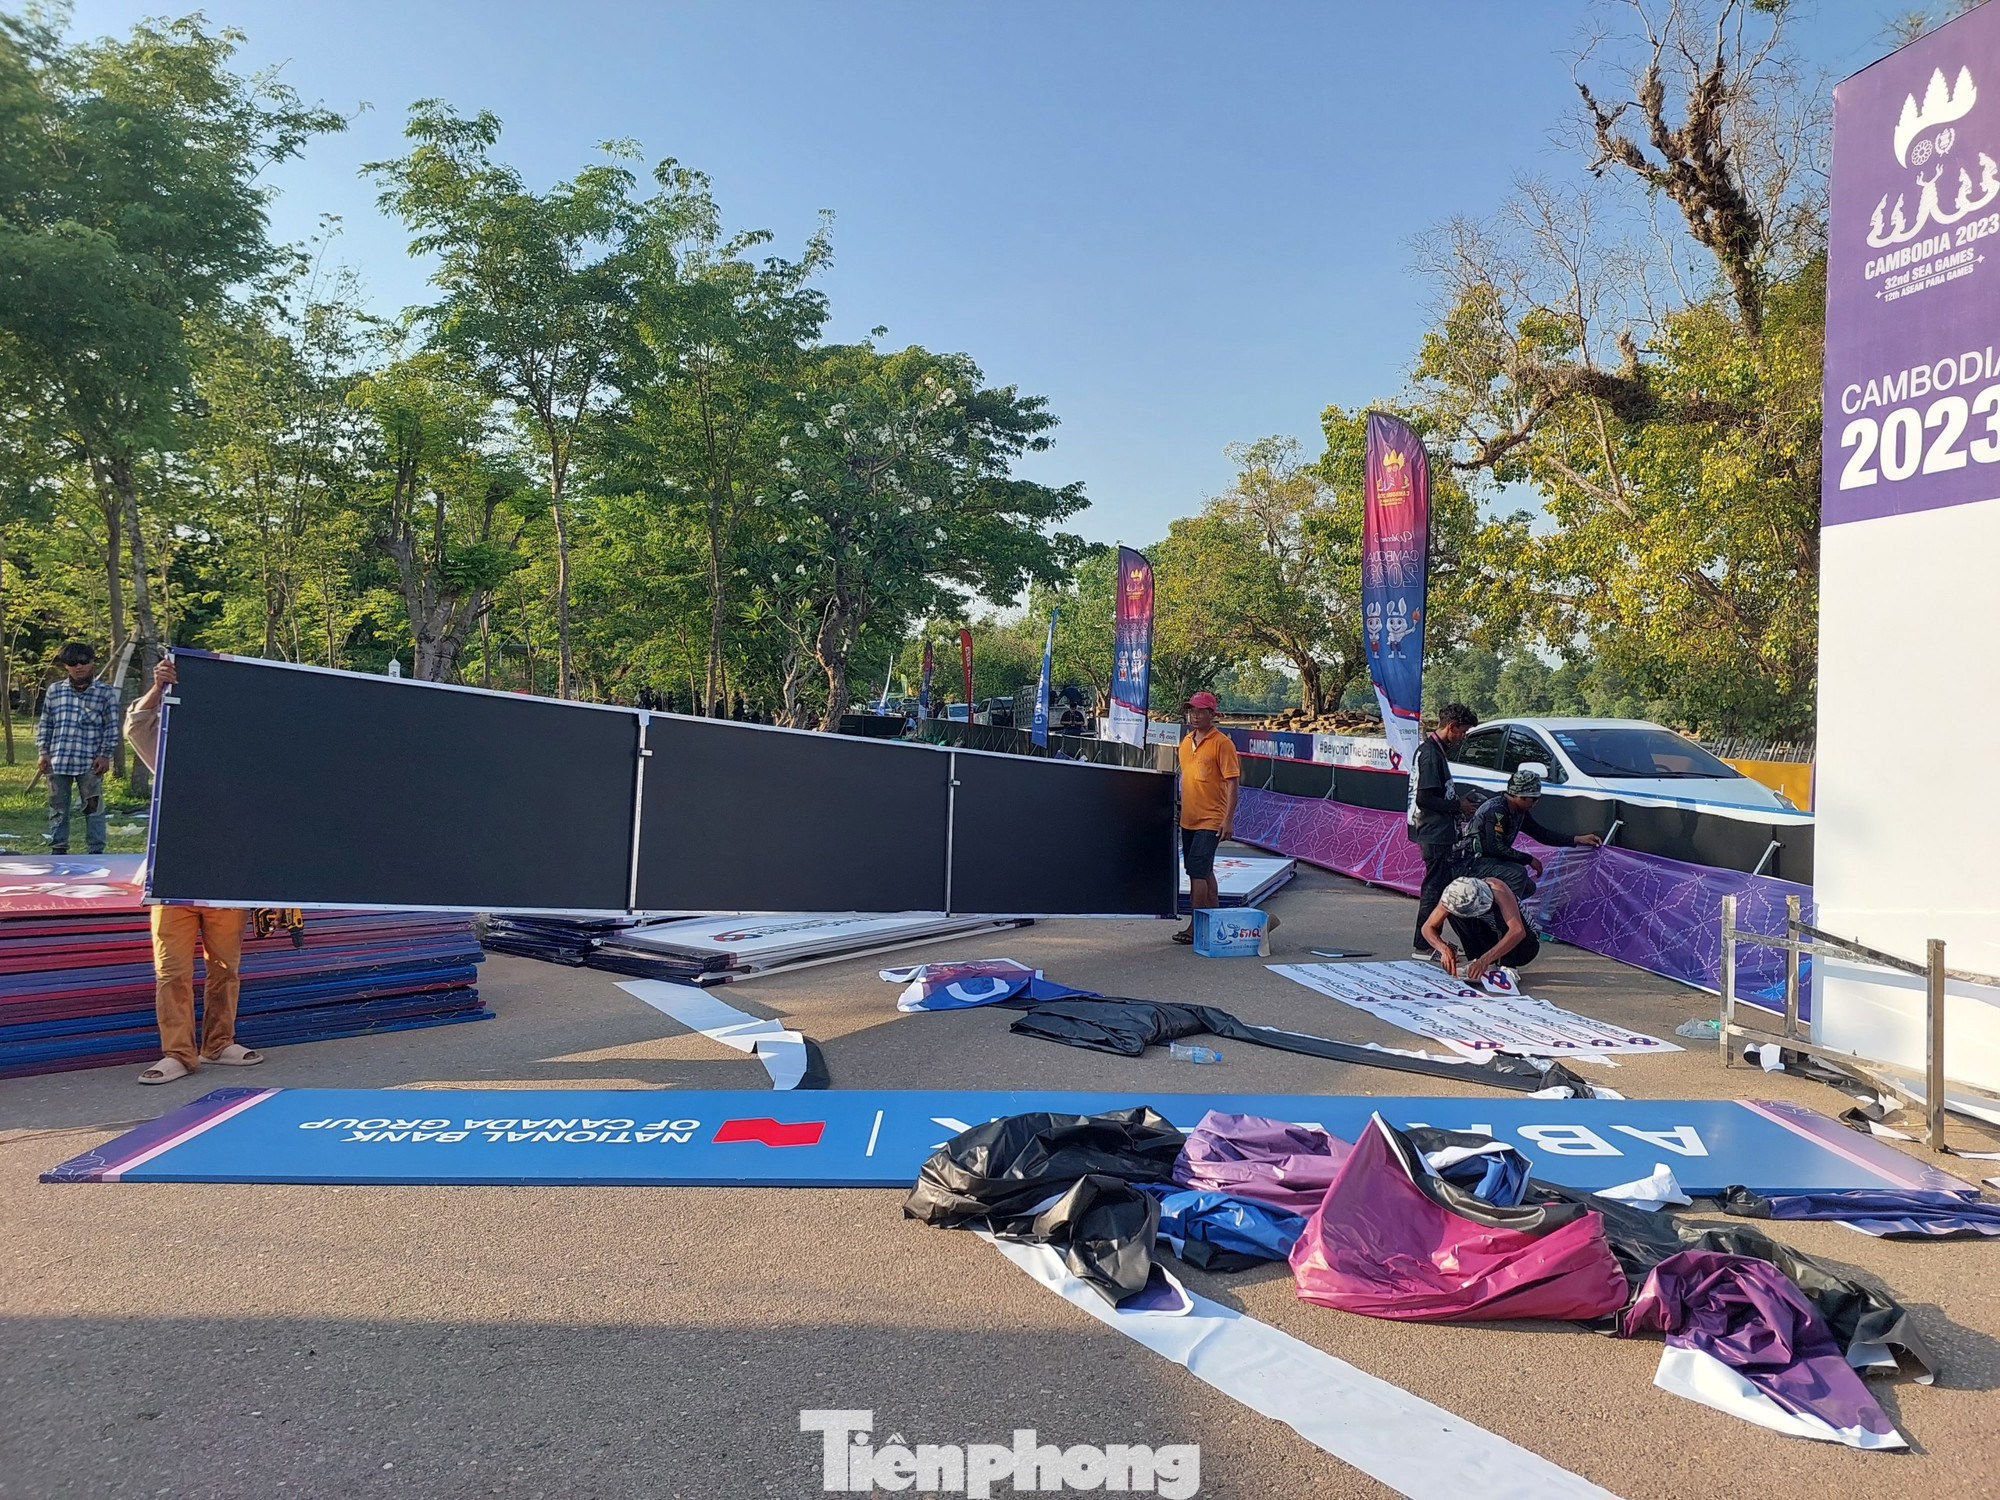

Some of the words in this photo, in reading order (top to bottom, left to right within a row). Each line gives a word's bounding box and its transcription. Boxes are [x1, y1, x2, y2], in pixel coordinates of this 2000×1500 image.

[1864, 232, 1951, 280] CAMBODIA
[1955, 213, 1999, 247] 2023
[1884, 270, 1910, 290] 32nd
[1911, 262, 1933, 281] SEA
[1934, 247, 1974, 272] GAMES
[1884, 291, 1900, 302] 12th
[1900, 281, 1924, 297] ASEAN
[1925, 274, 1946, 288] PARA
[1946, 264, 1974, 281] GAMES
[1839, 383, 2000, 491] 2023
[1249, 738, 1278, 756] CAMBODIA
[1280, 741, 1295, 758] 2023
[1319, 741, 1388, 759] #BeyondTheGames
[299, 1118, 451, 1130] GROUP
[464, 1118, 635, 1131] CANADA
[641, 1119, 701, 1131] OF
[340, 1131, 470, 1143] BANK
[485, 1131, 693, 1143] NATIONAL
